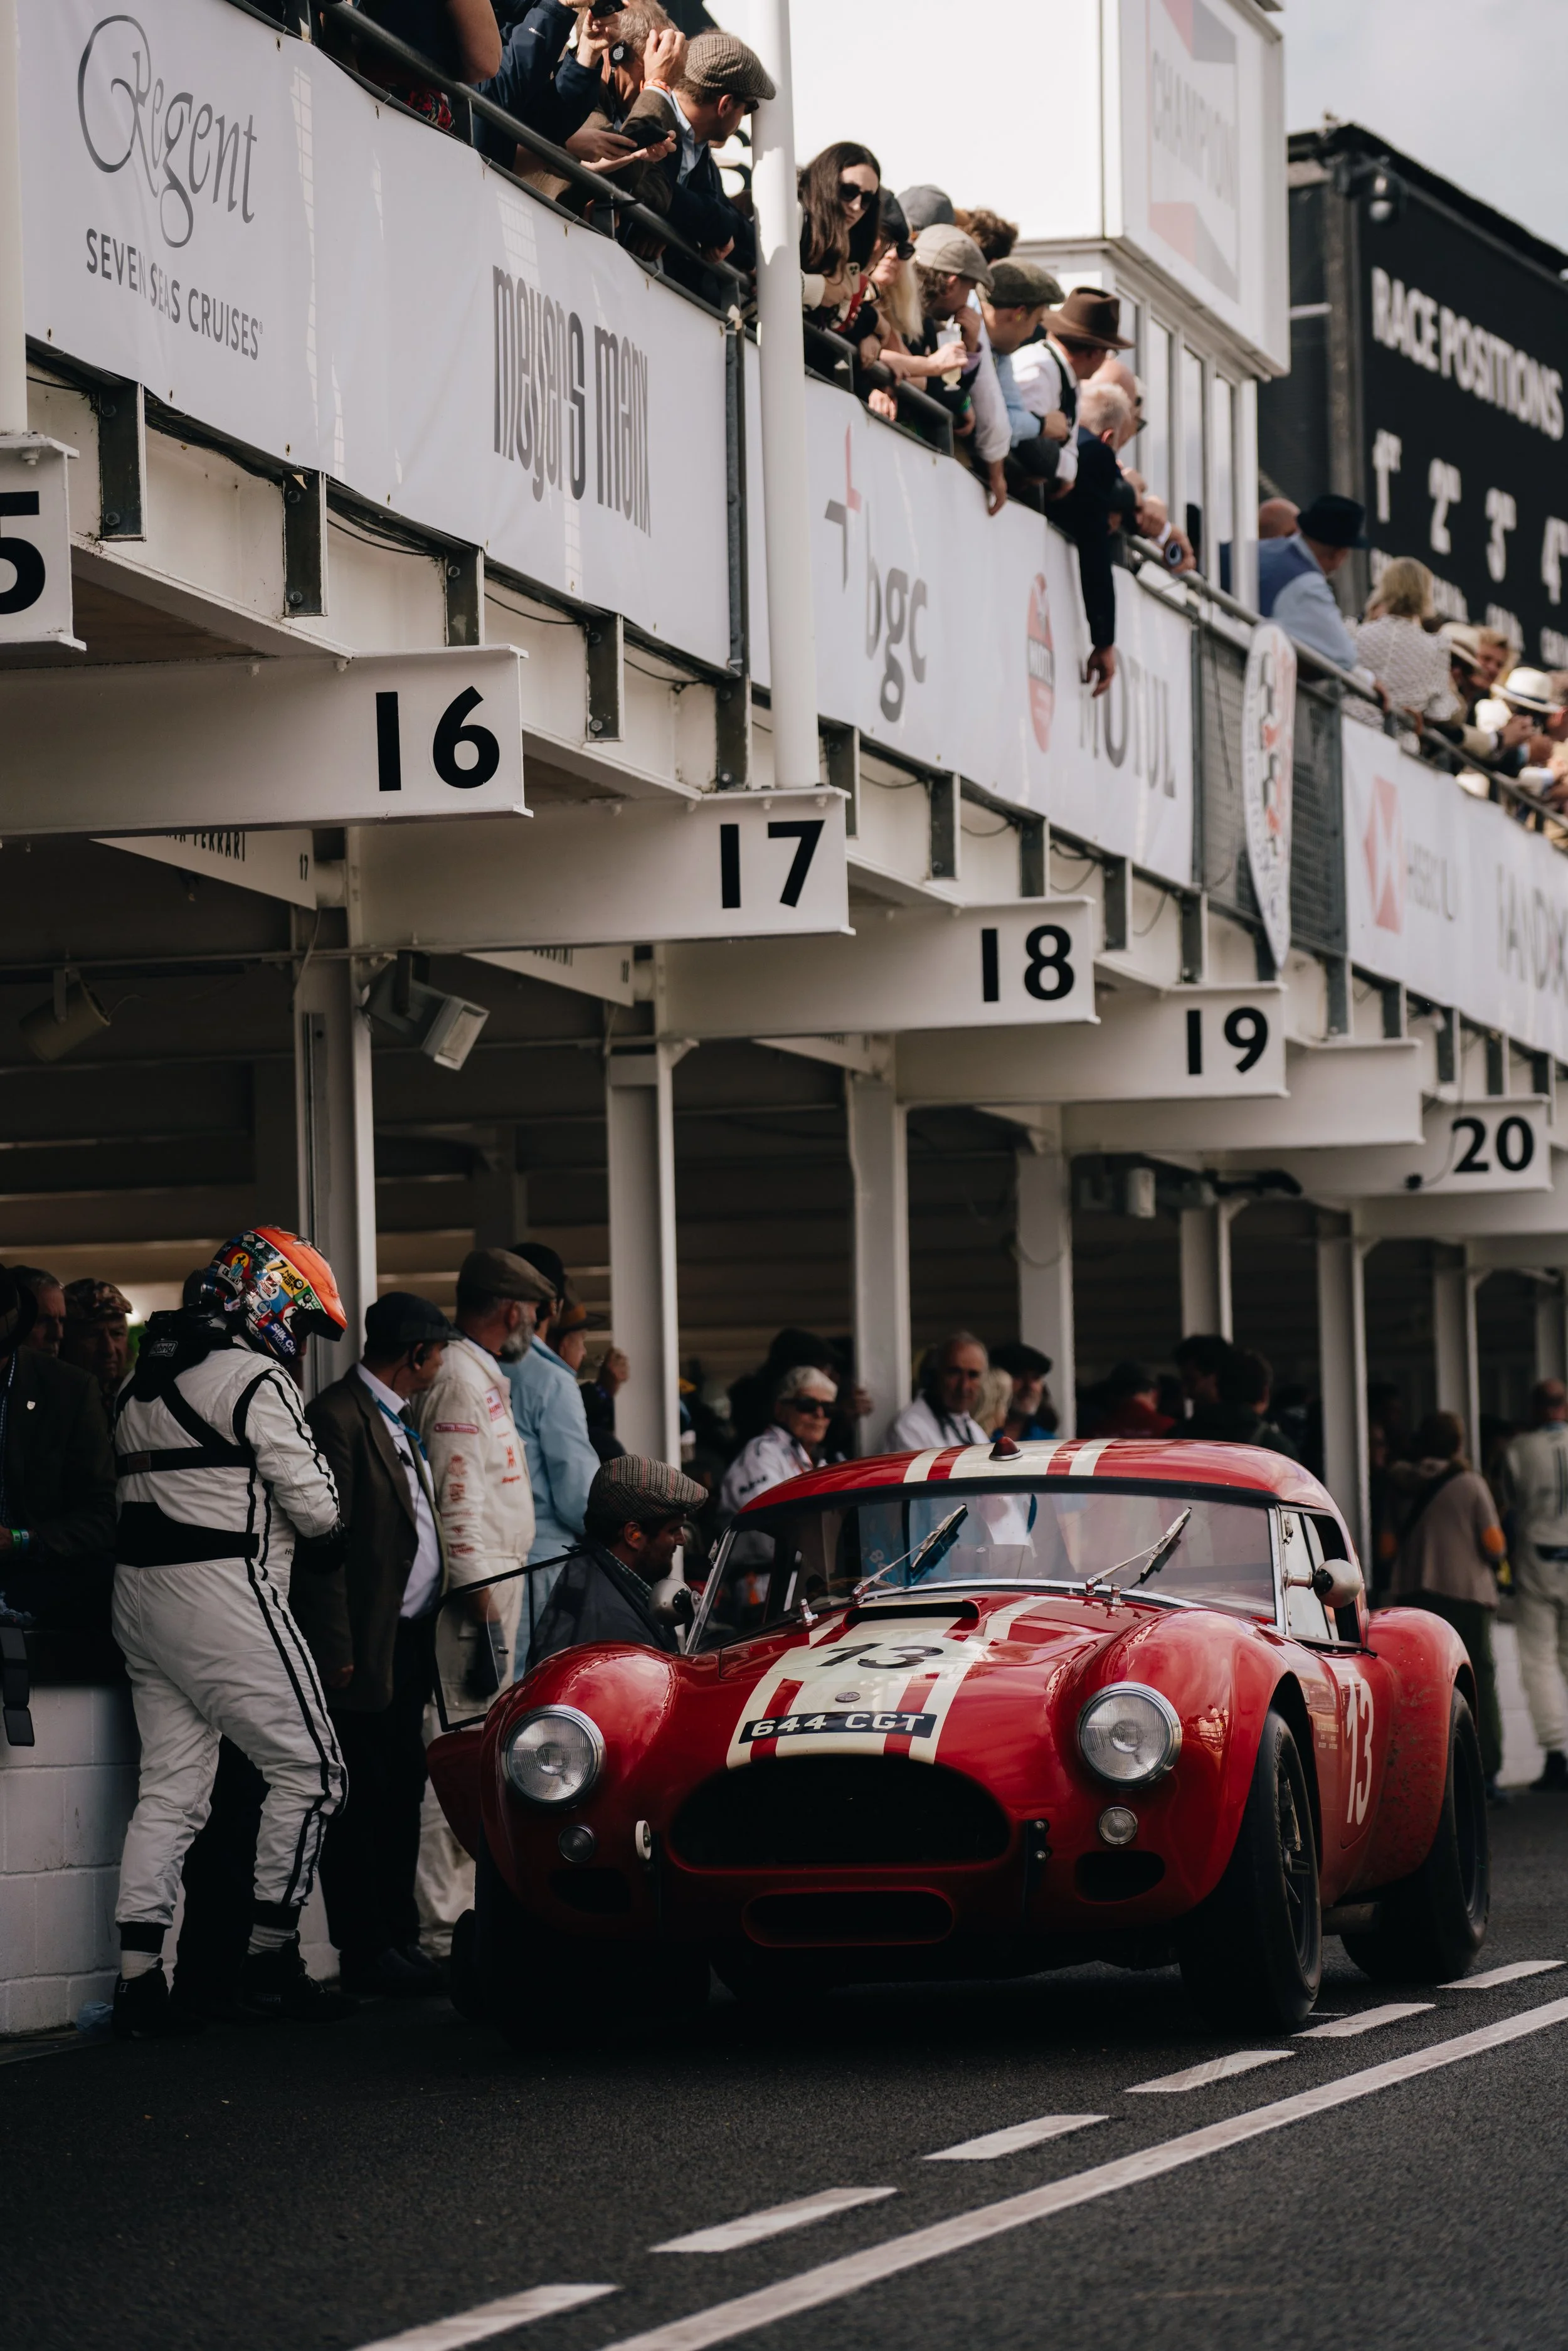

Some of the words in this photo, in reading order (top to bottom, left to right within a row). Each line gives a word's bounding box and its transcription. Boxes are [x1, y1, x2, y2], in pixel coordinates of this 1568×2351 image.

[77, 14, 257, 248] Regent
[87, 228, 146, 299] SEVEN
[150, 262, 181, 324] SEAS
[1372, 267, 1439, 373] RACE
[1441, 305, 1564, 440] POSITIONS
[376, 685, 501, 792] 16
[720, 819, 825, 908] 17
[982, 924, 1075, 1002] 18
[1187, 1006, 1269, 1075] 19
[1451, 1115, 1535, 1173] 20
[272, 1323, 286, 1339] Silk
[272, 1334, 289, 1353] JAGUAR
[816, 1643, 944, 1669] 13
[751, 1714, 827, 1737] 644
[845, 1713, 925, 1731] CGT
[1347, 1677, 1374, 1825] 13
